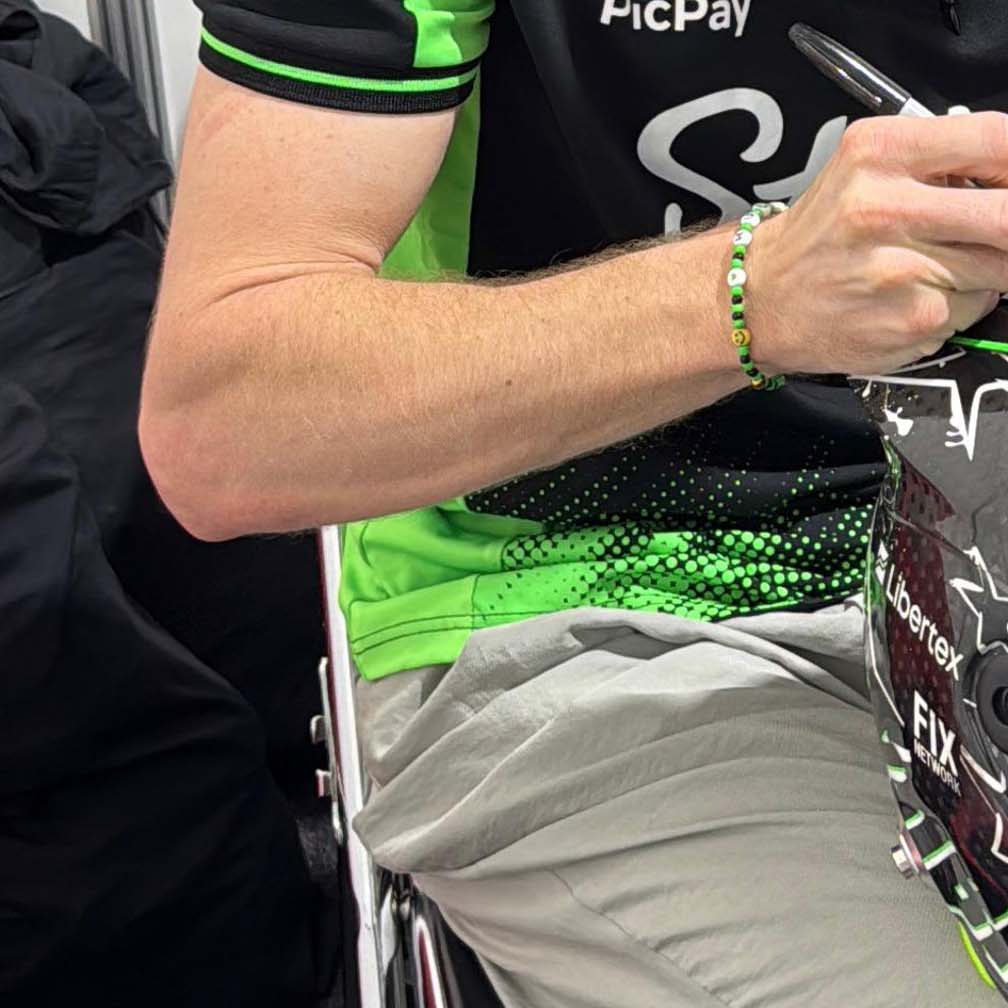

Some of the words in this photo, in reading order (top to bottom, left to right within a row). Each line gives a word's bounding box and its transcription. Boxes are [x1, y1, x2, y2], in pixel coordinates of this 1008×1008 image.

[886, 563, 964, 681] Libertex
[913, 689, 958, 777] FIX
[913, 738, 962, 798] NETWORK
